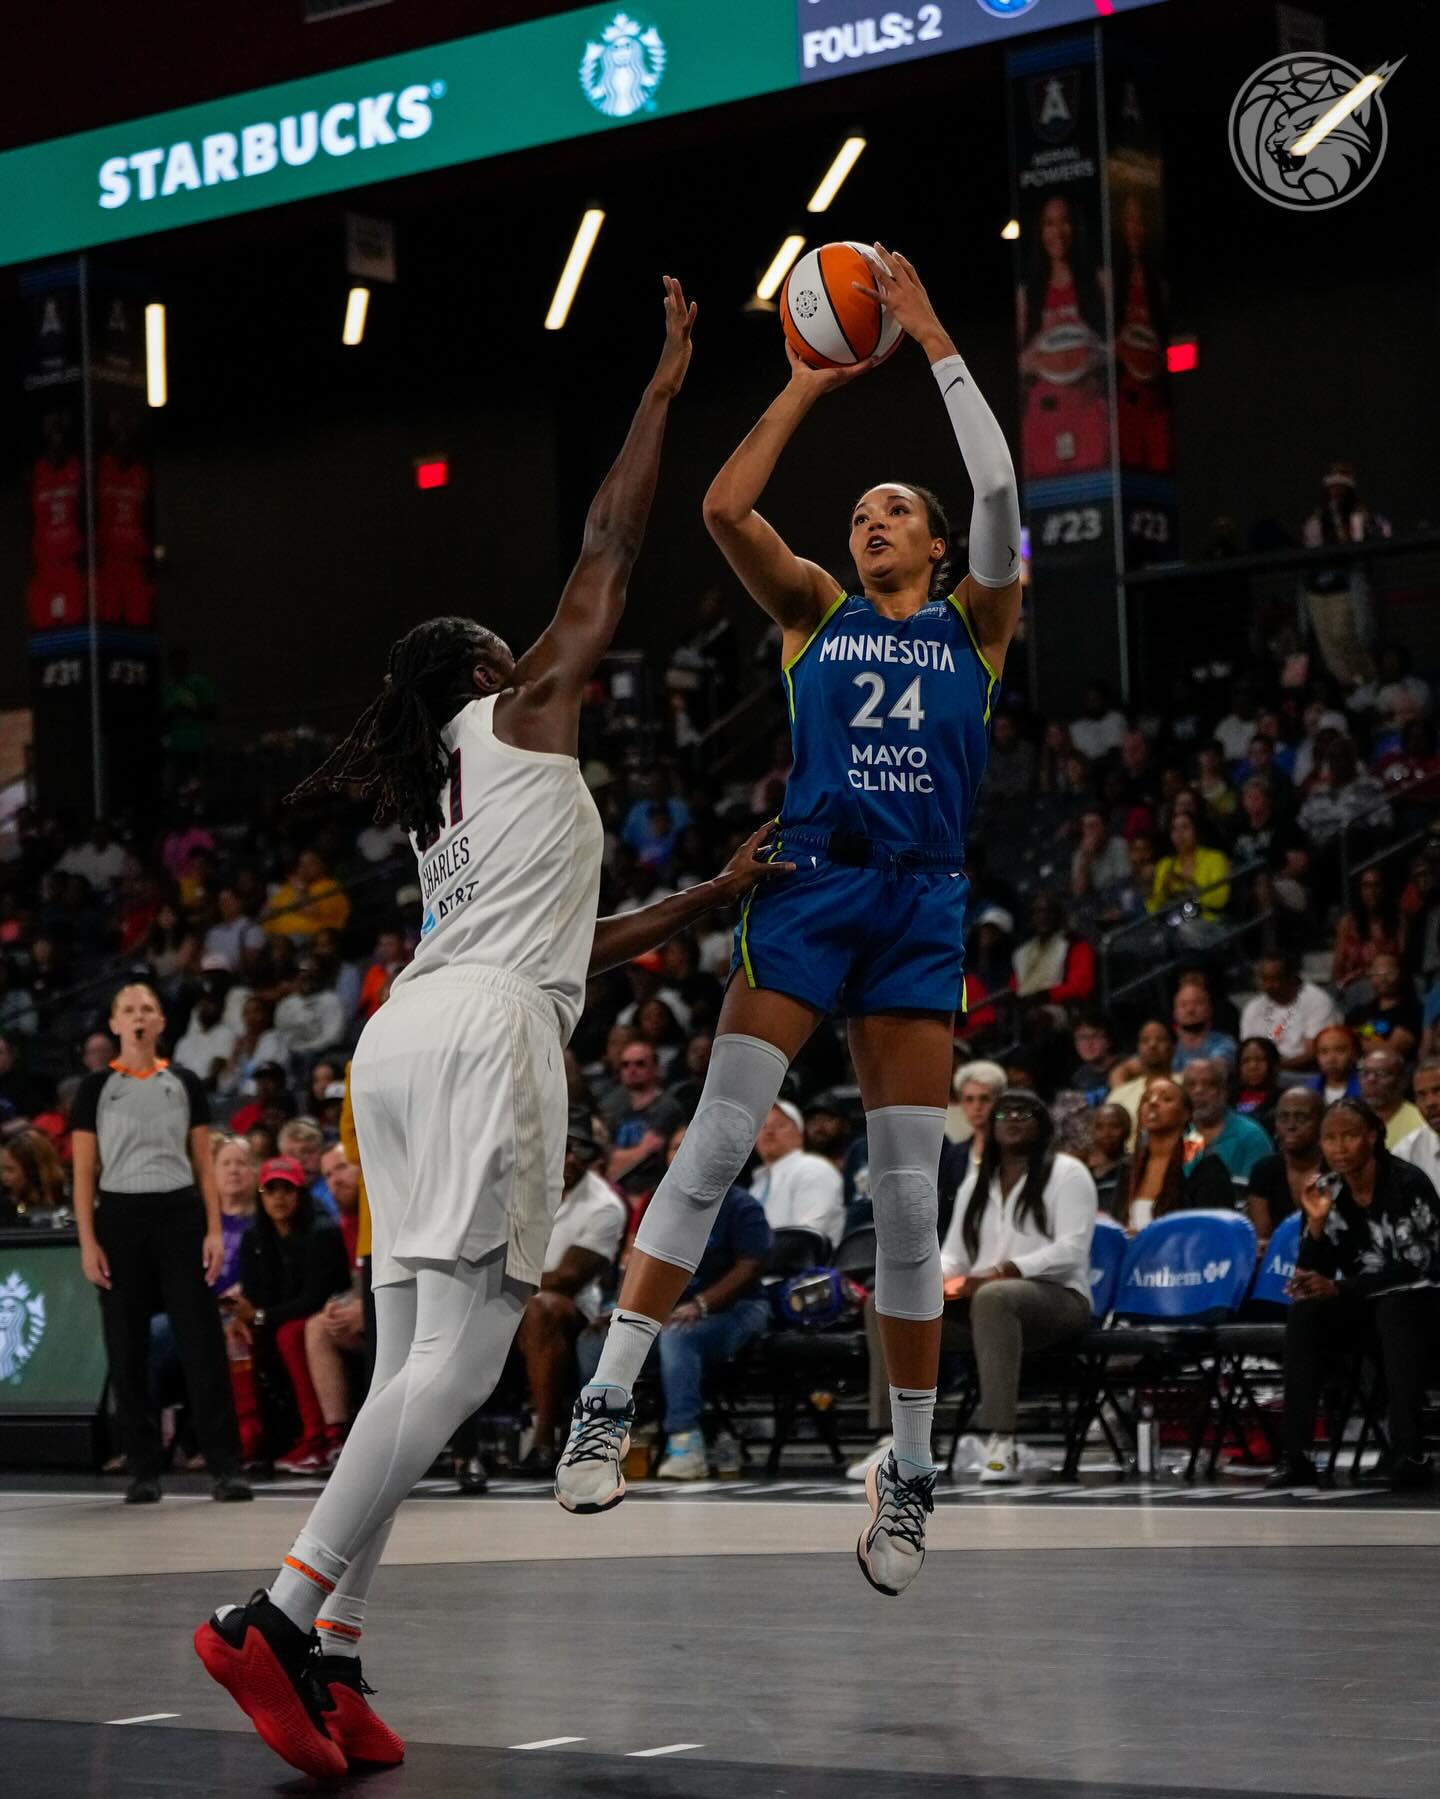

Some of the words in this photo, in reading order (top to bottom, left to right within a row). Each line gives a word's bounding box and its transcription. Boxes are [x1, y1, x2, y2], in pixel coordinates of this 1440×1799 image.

[803, 12, 914, 68] FOULS:
[918, 4, 943, 41] 2
[98, 84, 432, 209] STARBUCKS
[1042, 508, 1101, 545] #23
[819, 634, 955, 673] MINNESOTA
[850, 671, 925, 731] 24
[851, 744, 927, 768] MAYO
[848, 770, 935, 793] CLINIC
[423, 836, 470, 900] CHARLES
[438, 880, 479, 920] AT&T
[1127, 1265, 1203, 1288] Anthem
